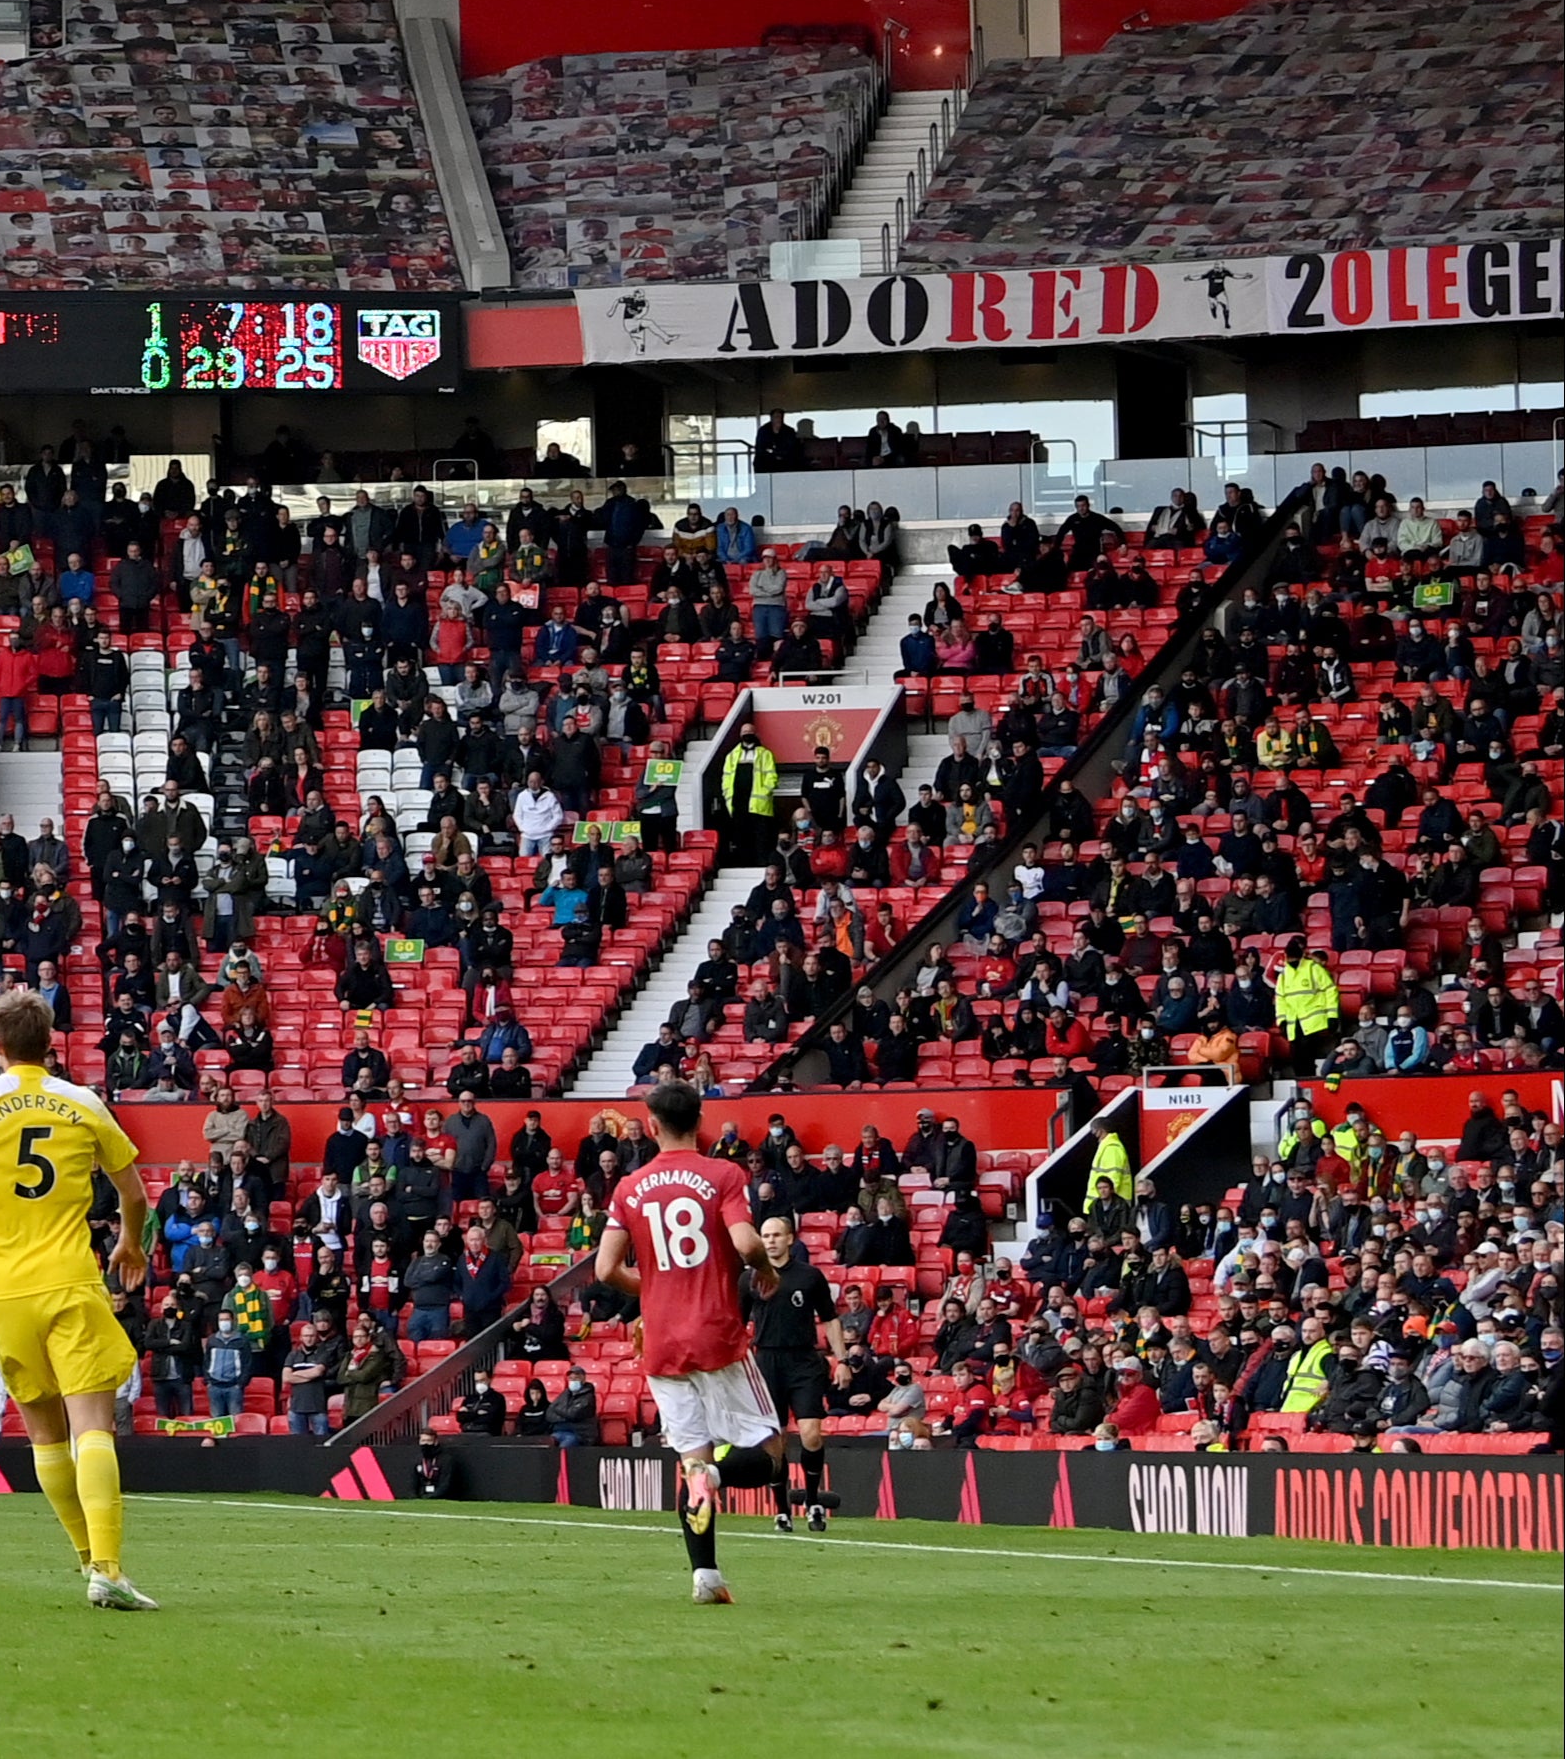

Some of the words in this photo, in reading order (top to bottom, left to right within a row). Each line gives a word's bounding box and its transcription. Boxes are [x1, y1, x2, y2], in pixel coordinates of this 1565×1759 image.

[1285, 239, 1564, 328] 20LEGE
[717, 263, 1161, 353] ADORED
[361, 314, 433, 337] TAG
[90, 387, 151, 395] DAKTRONICS
[1425, 586, 1441, 596] GO
[802, 694, 842, 705] W201
[656, 761, 674, 774] GO
[395, 940, 414, 952] GO
[1167, 1093, 1202, 1105] N1413
[15, 1126, 57, 1201] 5
[626, 1169, 717, 1210] B.FERNANDES
[642, 1196, 711, 1272] 18
[204, 1421, 223, 1434] GO
[1129, 1462, 1189, 1537] SHOP
[1195, 1463, 1248, 1541] NOW
